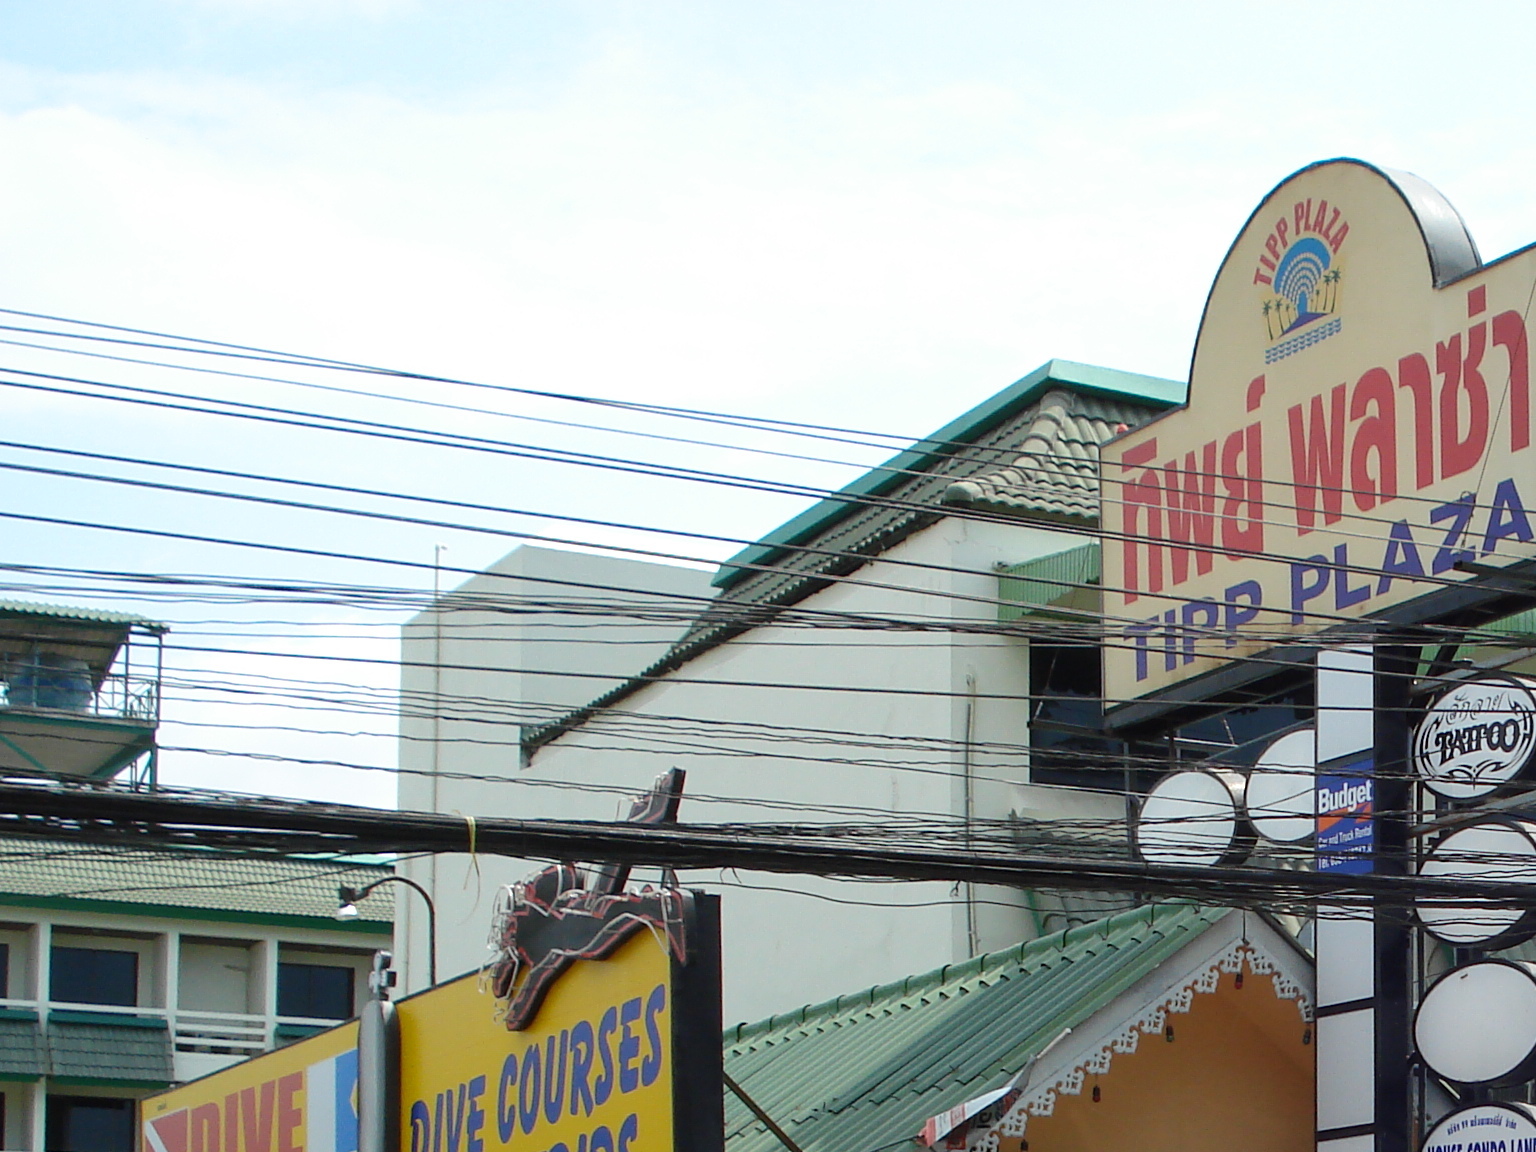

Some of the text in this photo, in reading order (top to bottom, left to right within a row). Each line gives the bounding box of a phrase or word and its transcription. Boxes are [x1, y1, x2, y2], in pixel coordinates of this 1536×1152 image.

[1253, 198, 1350, 287] TIPP PLAZA
[1121, 374, 1266, 605] ทิพย์
[1123, 478, 1535, 682] TIPP PLAZA
[1319, 779, 1372, 814] Budget
[1435, 719, 1520, 766] TATTOO
[497, 984, 665, 1144] COURSES
